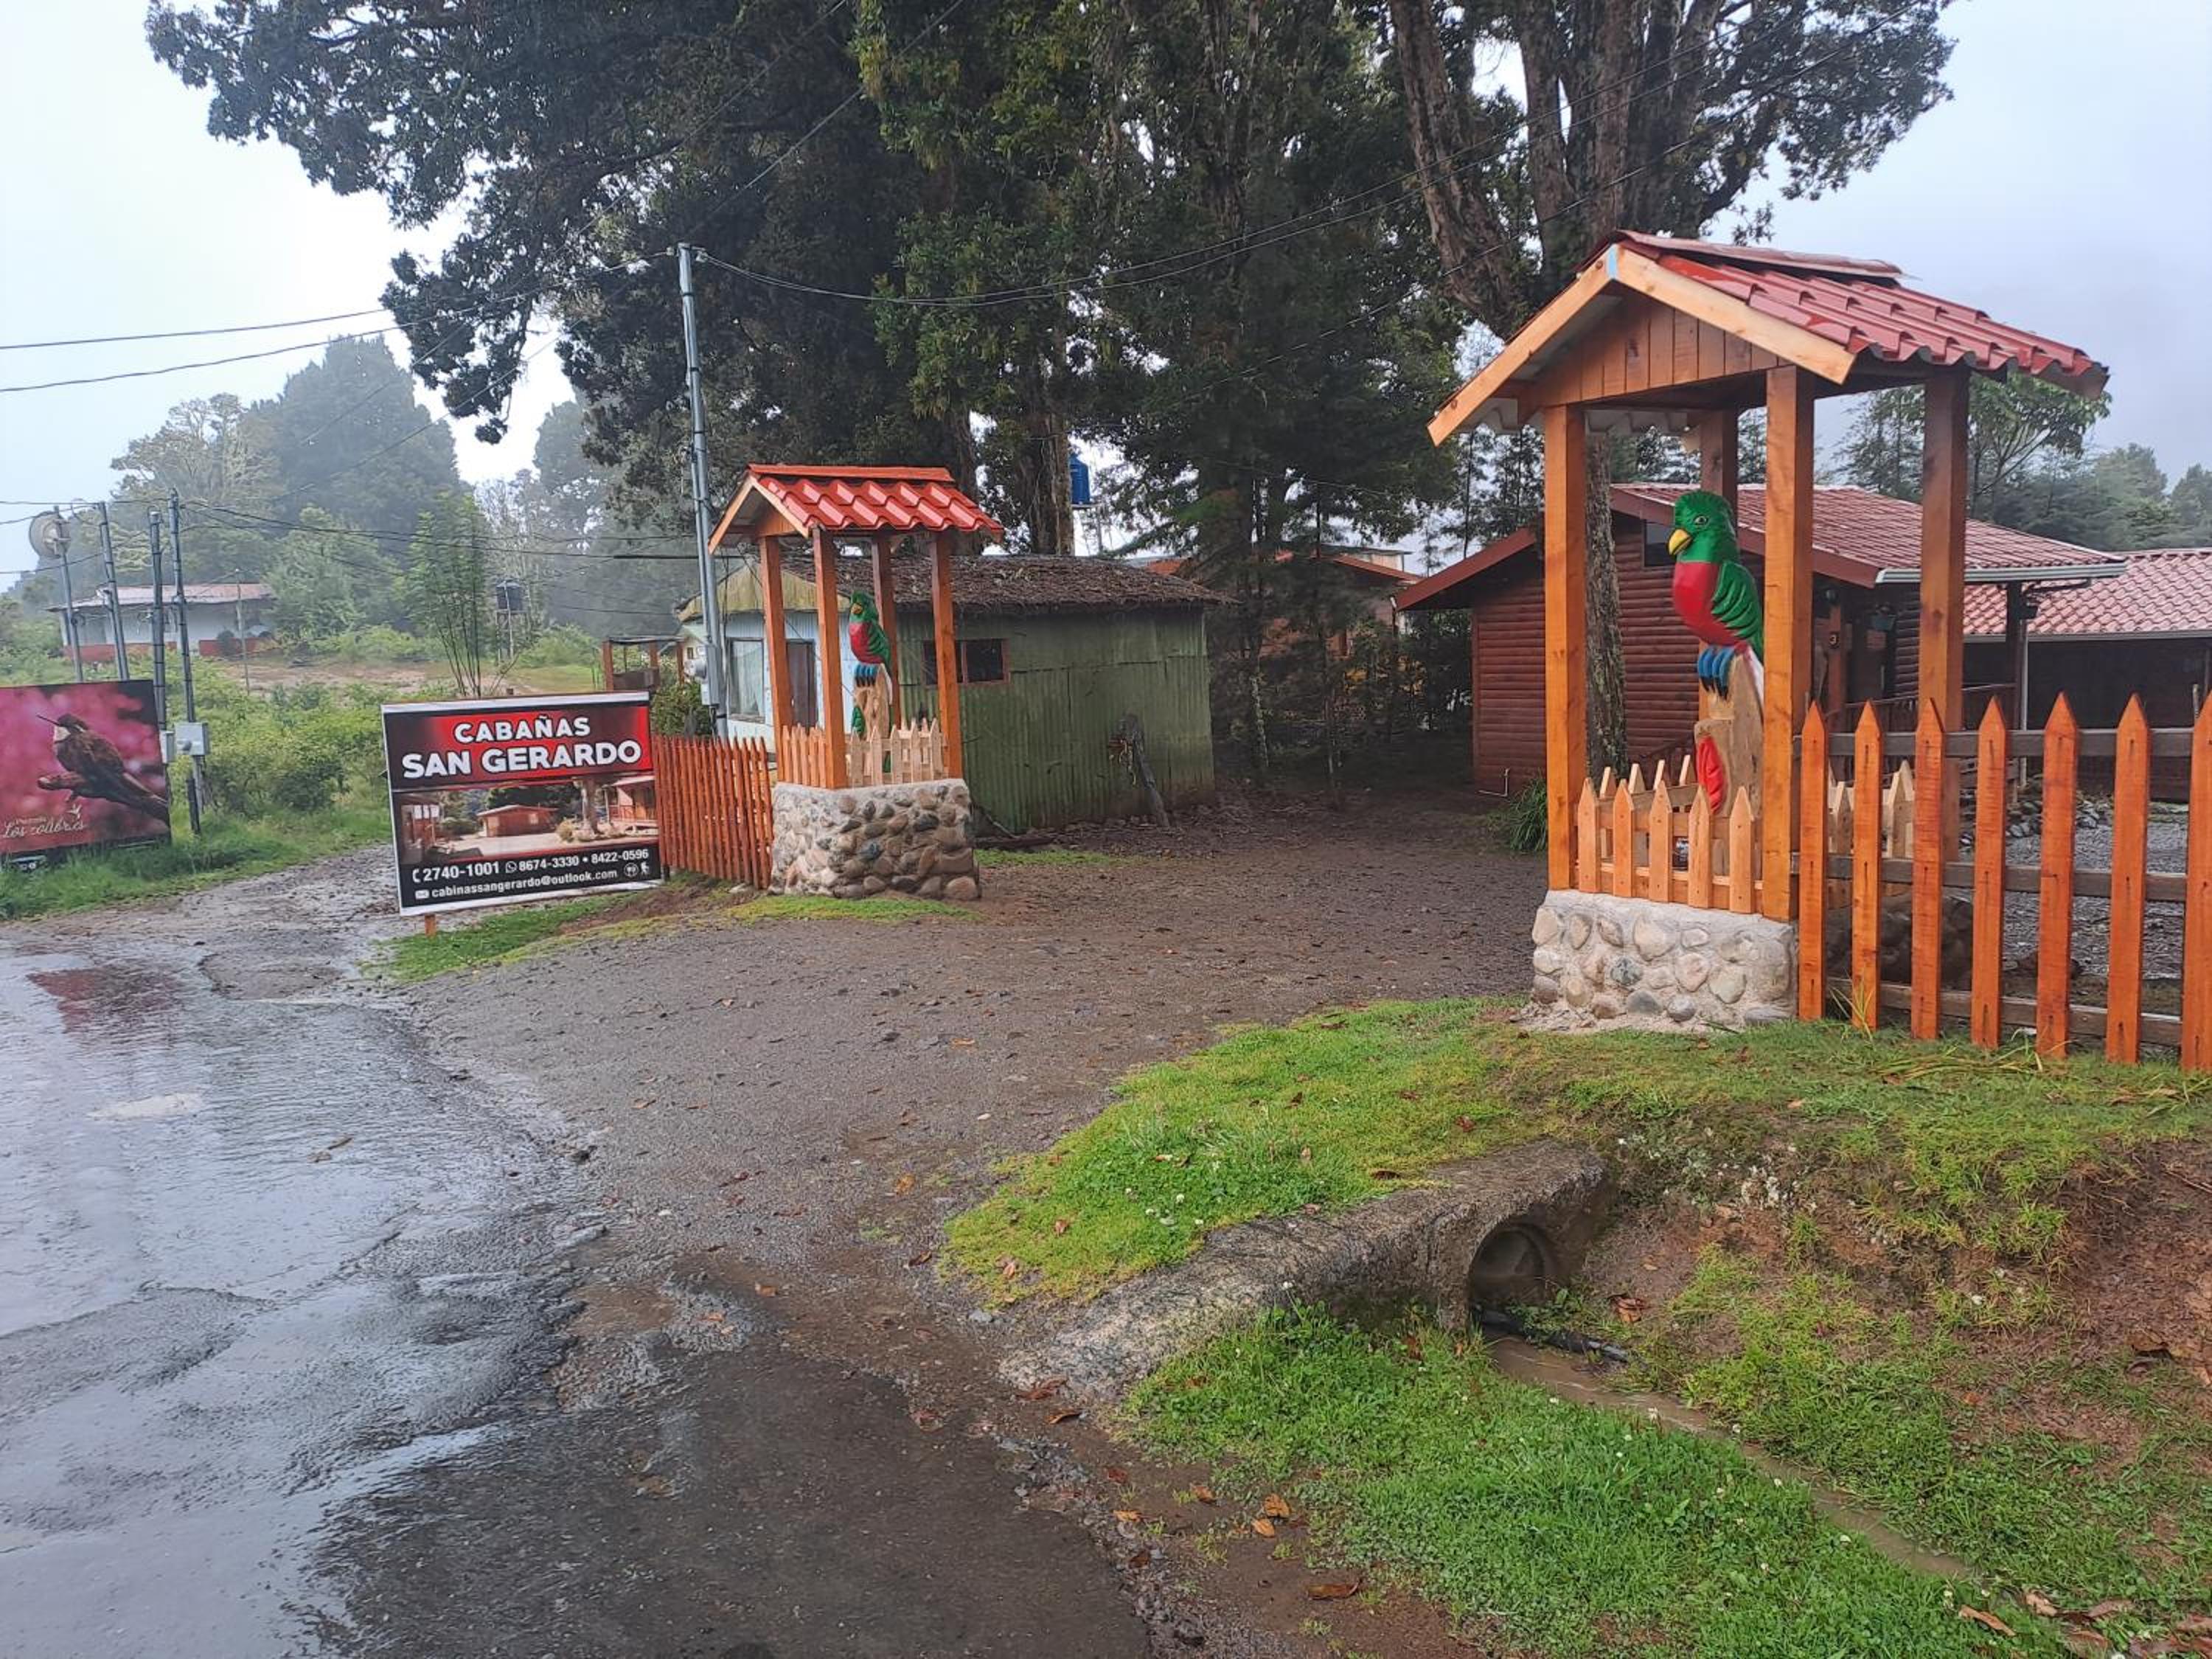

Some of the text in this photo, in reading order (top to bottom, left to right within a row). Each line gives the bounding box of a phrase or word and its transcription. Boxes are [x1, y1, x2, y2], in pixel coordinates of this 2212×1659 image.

[454, 714, 591, 743] CABAÑAS
[402, 740, 641, 779] SAN GERARDO
[422, 849, 649, 882] 2740-1001 8674-3330 8422-0596
[431, 870, 618, 897] cabinassangerardo@outlook.com
